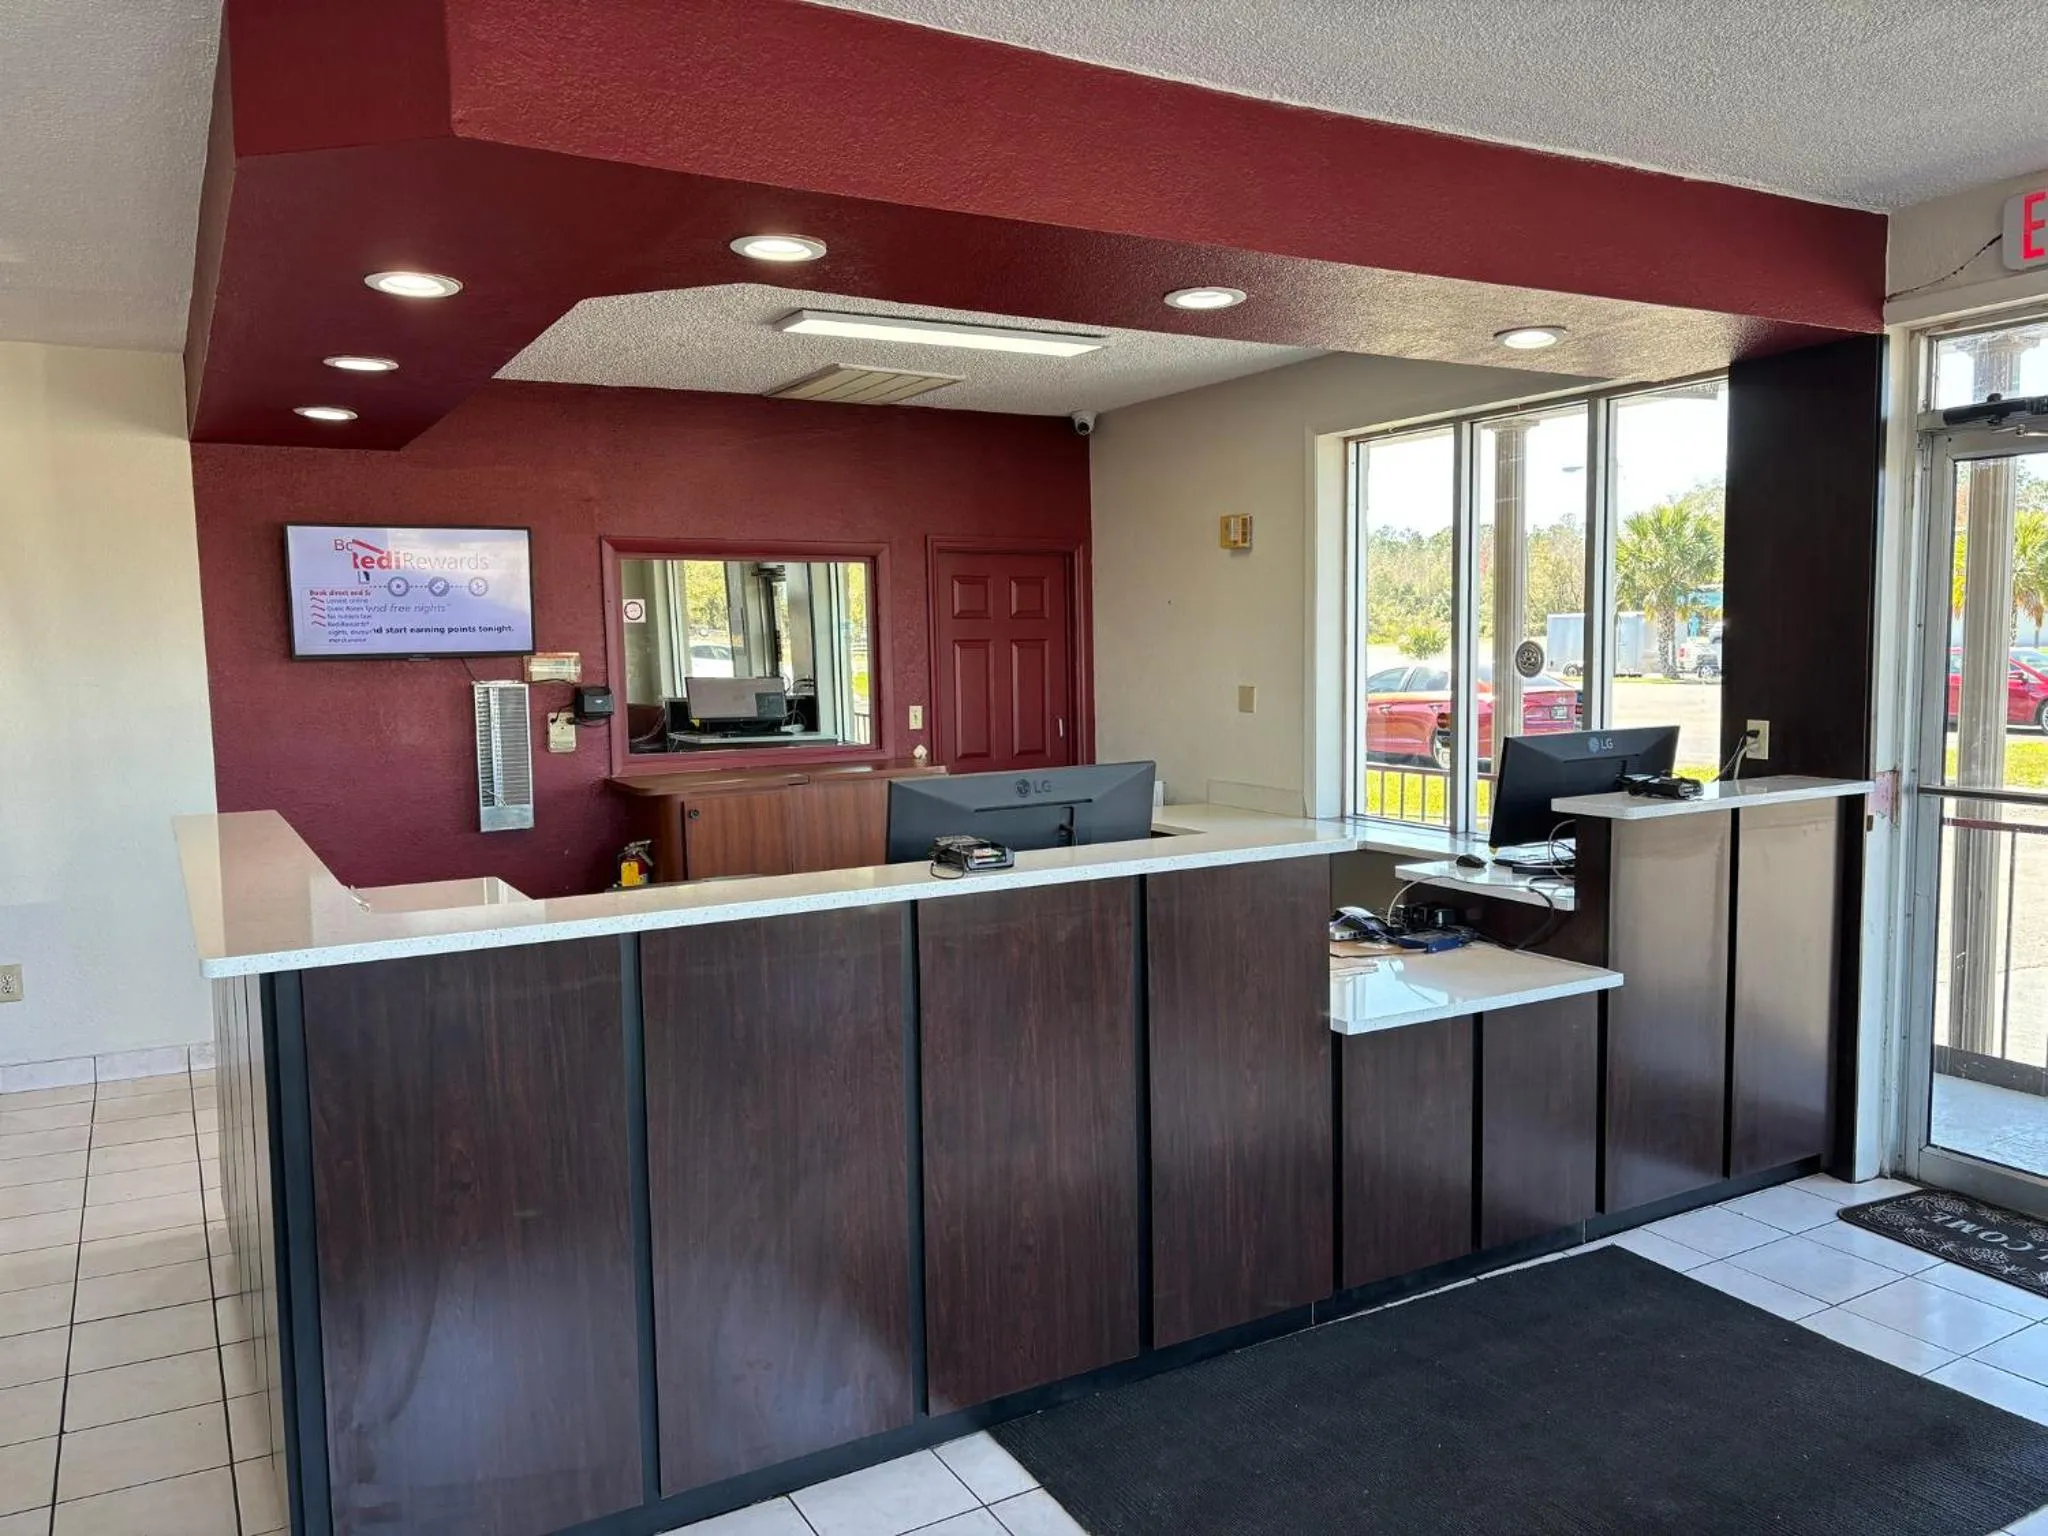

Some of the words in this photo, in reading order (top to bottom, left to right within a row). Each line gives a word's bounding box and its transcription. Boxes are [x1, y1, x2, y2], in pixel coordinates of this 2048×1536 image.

[385, 625, 407, 634] start
[409, 625, 445, 637] earning
[447, 623, 476, 636] points
[478, 622, 514, 636] tonight.
[1600, 737, 1613, 749] LG
[1033, 780, 1052, 793] LG
